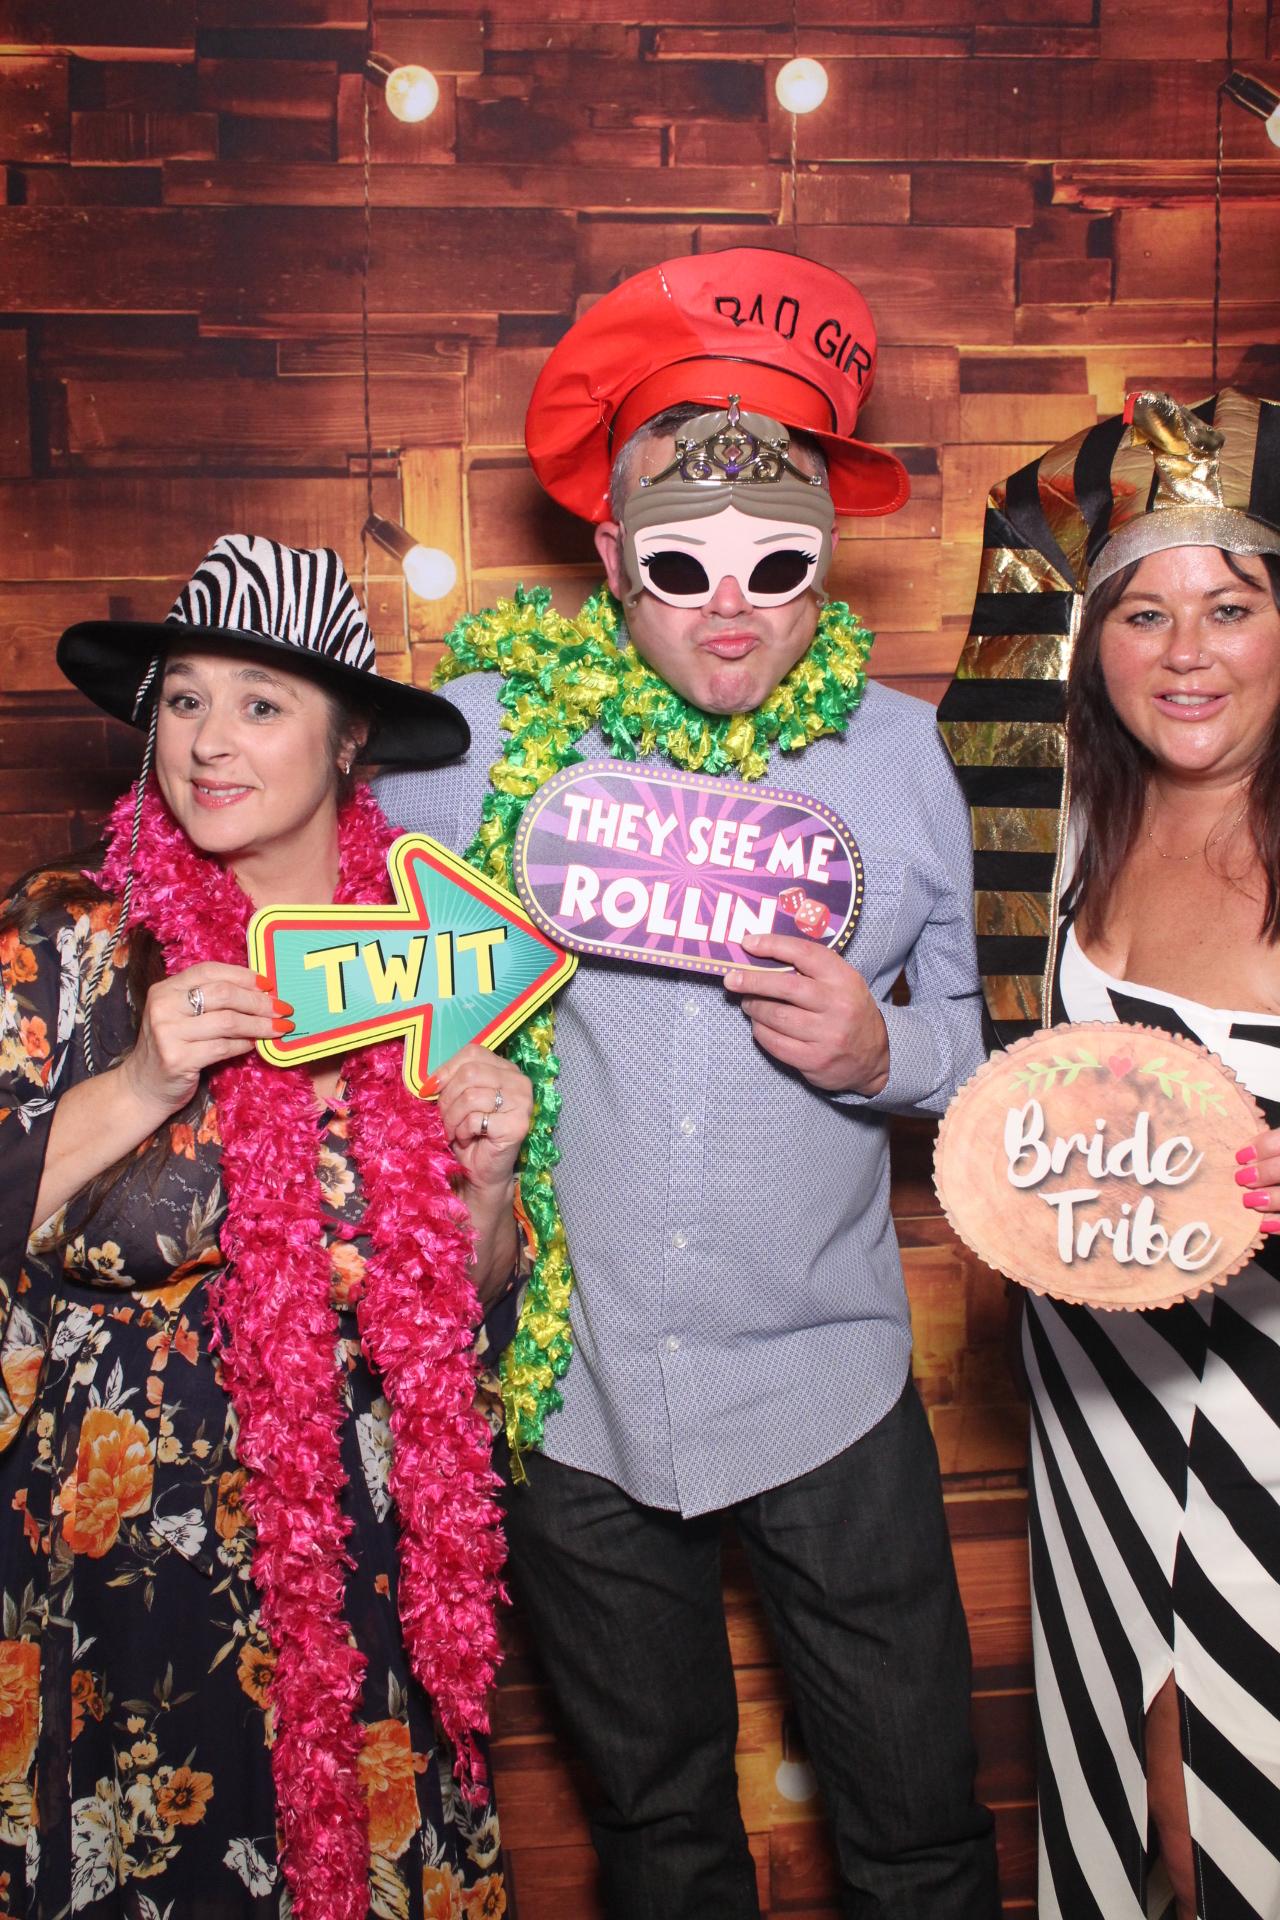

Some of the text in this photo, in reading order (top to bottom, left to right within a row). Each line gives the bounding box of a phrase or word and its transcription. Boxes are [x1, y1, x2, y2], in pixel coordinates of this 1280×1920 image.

[563, 793, 836, 885] THEY SEE ME
[559, 864, 779, 945] ROLLIN
[303, 926, 508, 1014] TWIT
[1003, 1099, 1205, 1188] Bride
[1037, 1188, 1223, 1271] Tribe
